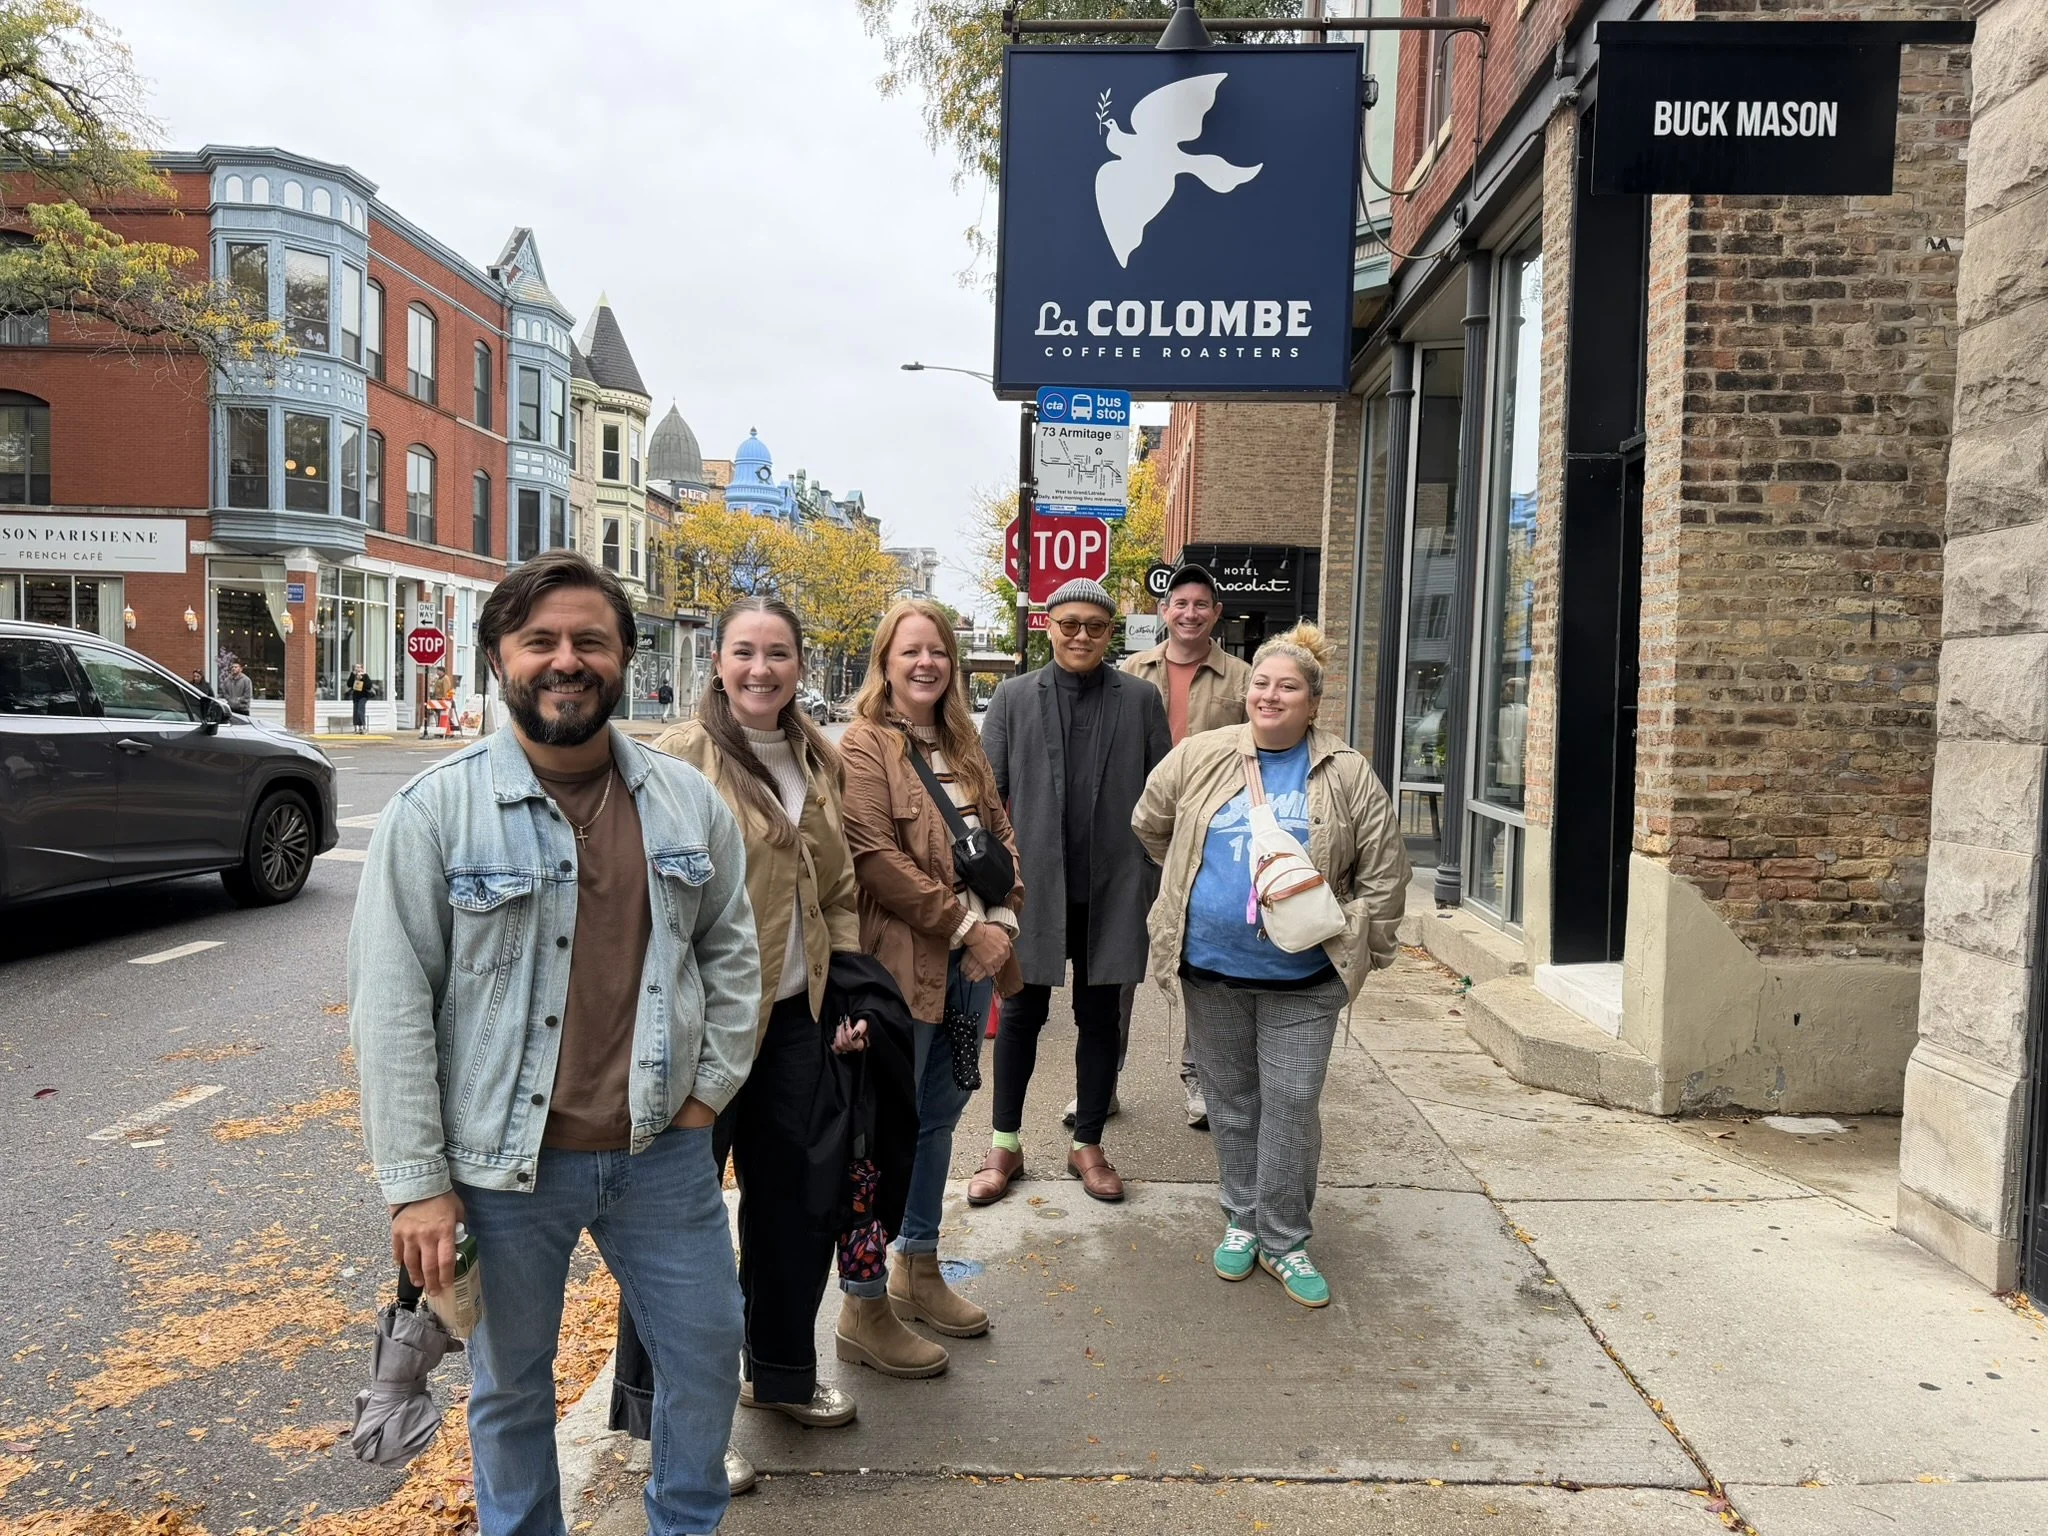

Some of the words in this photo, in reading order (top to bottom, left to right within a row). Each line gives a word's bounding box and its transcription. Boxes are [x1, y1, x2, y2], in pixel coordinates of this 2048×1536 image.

[1653, 100, 1730, 137] BUCK
[1736, 101, 1838, 137] MASON
[1034, 301, 1079, 336] La
[1087, 300, 1313, 337] COLOMBE
[1044, 346, 1141, 358] COFFEE
[1162, 347, 1299, 358] ROASTERS
[1046, 401, 1064, 411] cta
[1097, 394, 1121, 407] bus
[1096, 408, 1126, 423] stop
[1042, 427, 1056, 437] 73
[1059, 427, 1112, 441] Armitage
[2, 528, 37, 541] SON
[45, 529, 158, 543] PARISIENNE
[19, 550, 67, 560] FRENCH
[73, 550, 103, 561] CAFÉ
[1224, 567, 1259, 575] HOTEL
[1214, 577, 1291, 592] hocolat.
[419, 611, 434, 619] WAY
[409, 636, 444, 652] STOP
